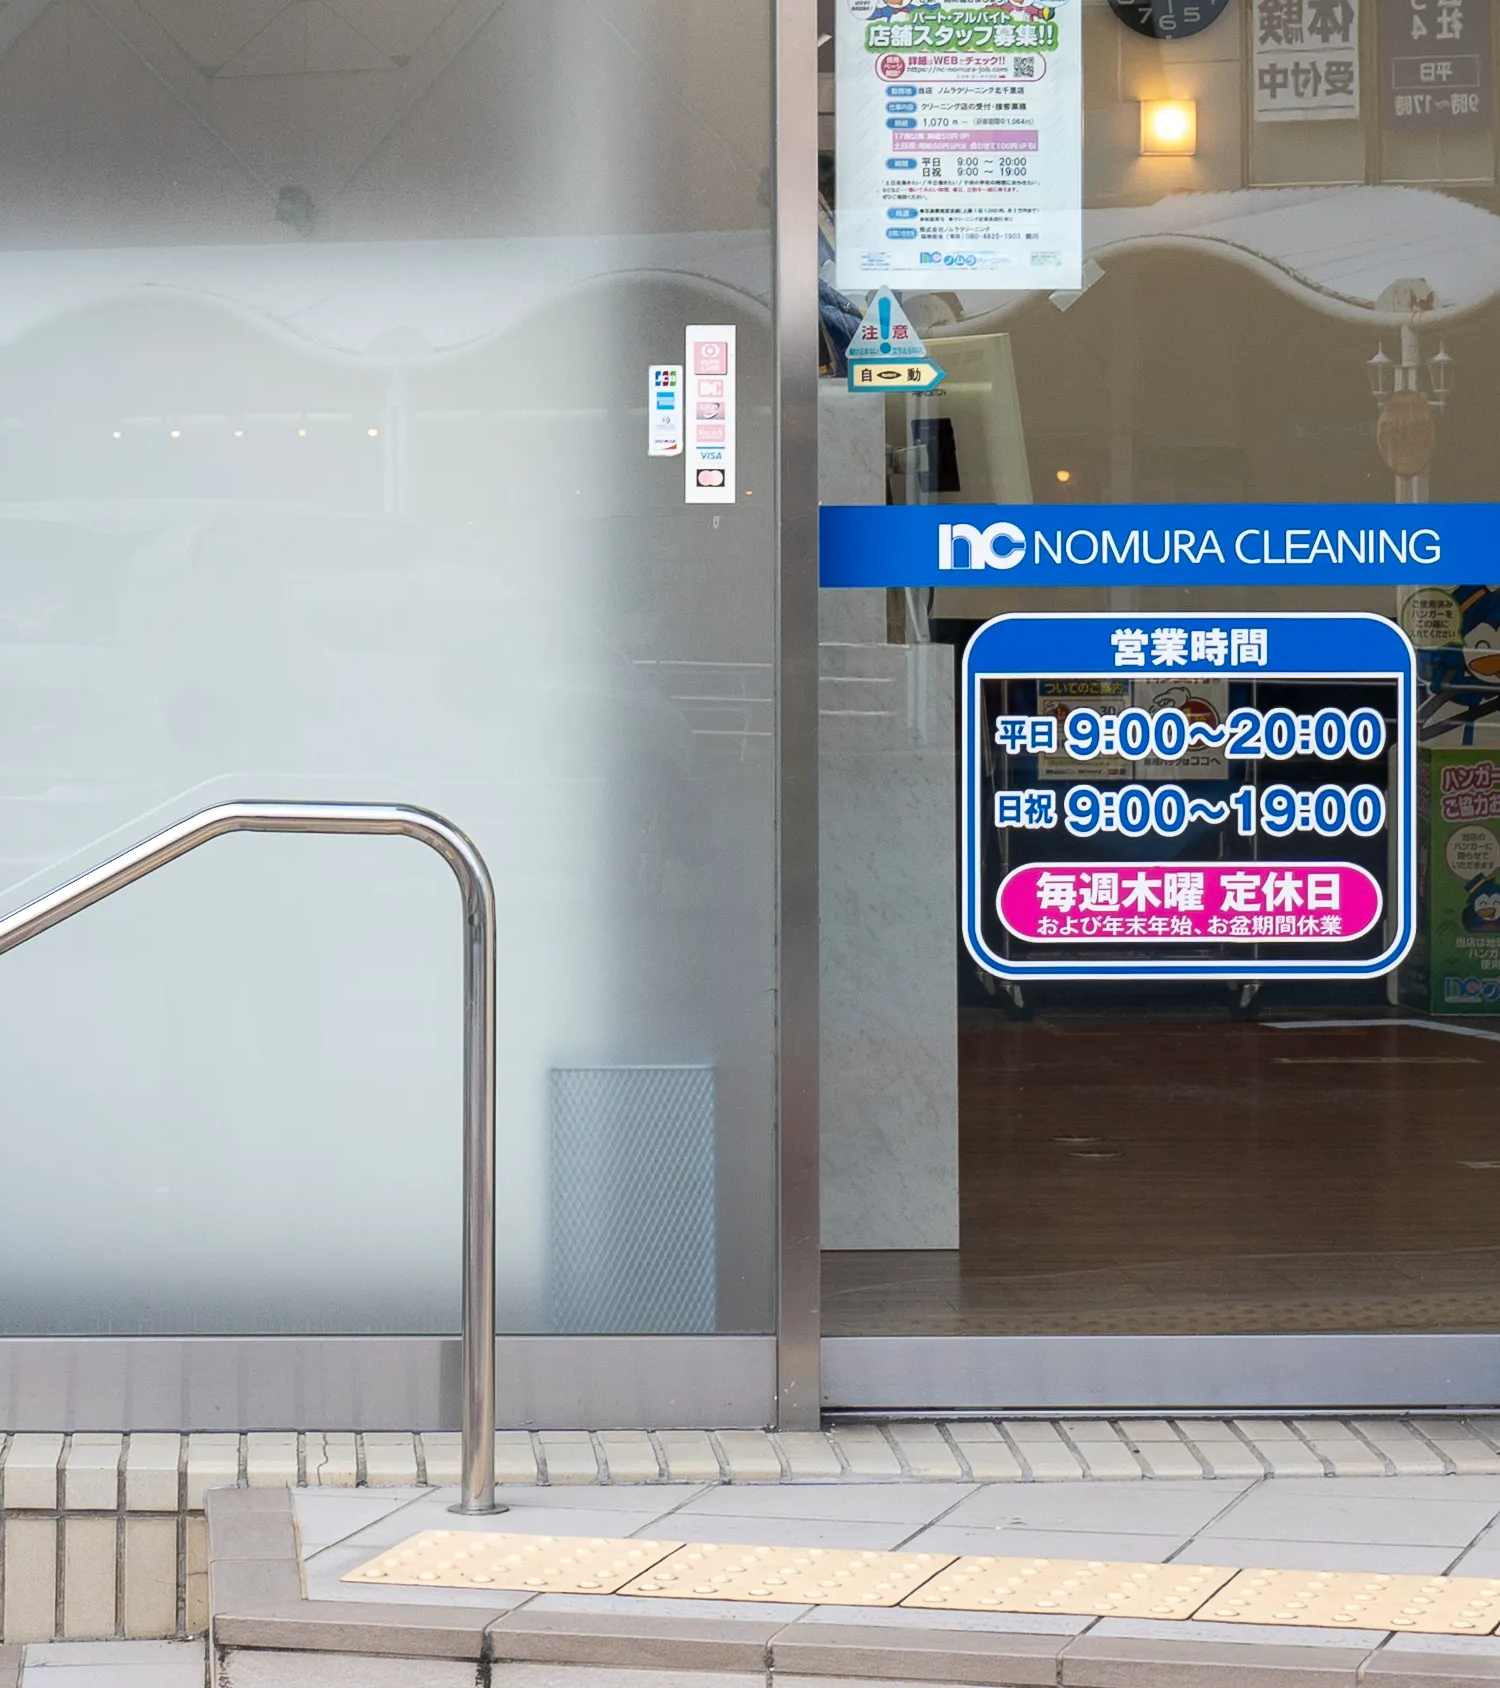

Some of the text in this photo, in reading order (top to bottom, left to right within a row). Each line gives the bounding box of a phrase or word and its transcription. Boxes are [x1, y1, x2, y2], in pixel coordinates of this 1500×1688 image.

[912, 11, 1012, 25] パート・アルバイト
[1138, 7, 1152, 24] 7
[1159, 14, 1177, 30] 6
[1184, 7, 1201, 22] 5
[868, 24, 1054, 48] 店舗スタッフ募集!!
[921, 157, 1028, 167] 平日 9:00 20:00
[922, 167, 1028, 177] 日祝 9:00 19:00
[861, 324, 909, 341] 注意
[861, 368, 921, 383] 自動
[700, 451, 723, 460] VISA
[938, 522, 1442, 570] nc NOMURA CLEANING
[1110, 629, 1270, 667] 営業時間
[996, 717, 1057, 755] 平日
[996, 790, 1057, 827] 日祝
[1036, 872, 1343, 913] 毎週木曜 定休日
[1036, 915, 1343, 937] および年末年始、お盆期間休業
